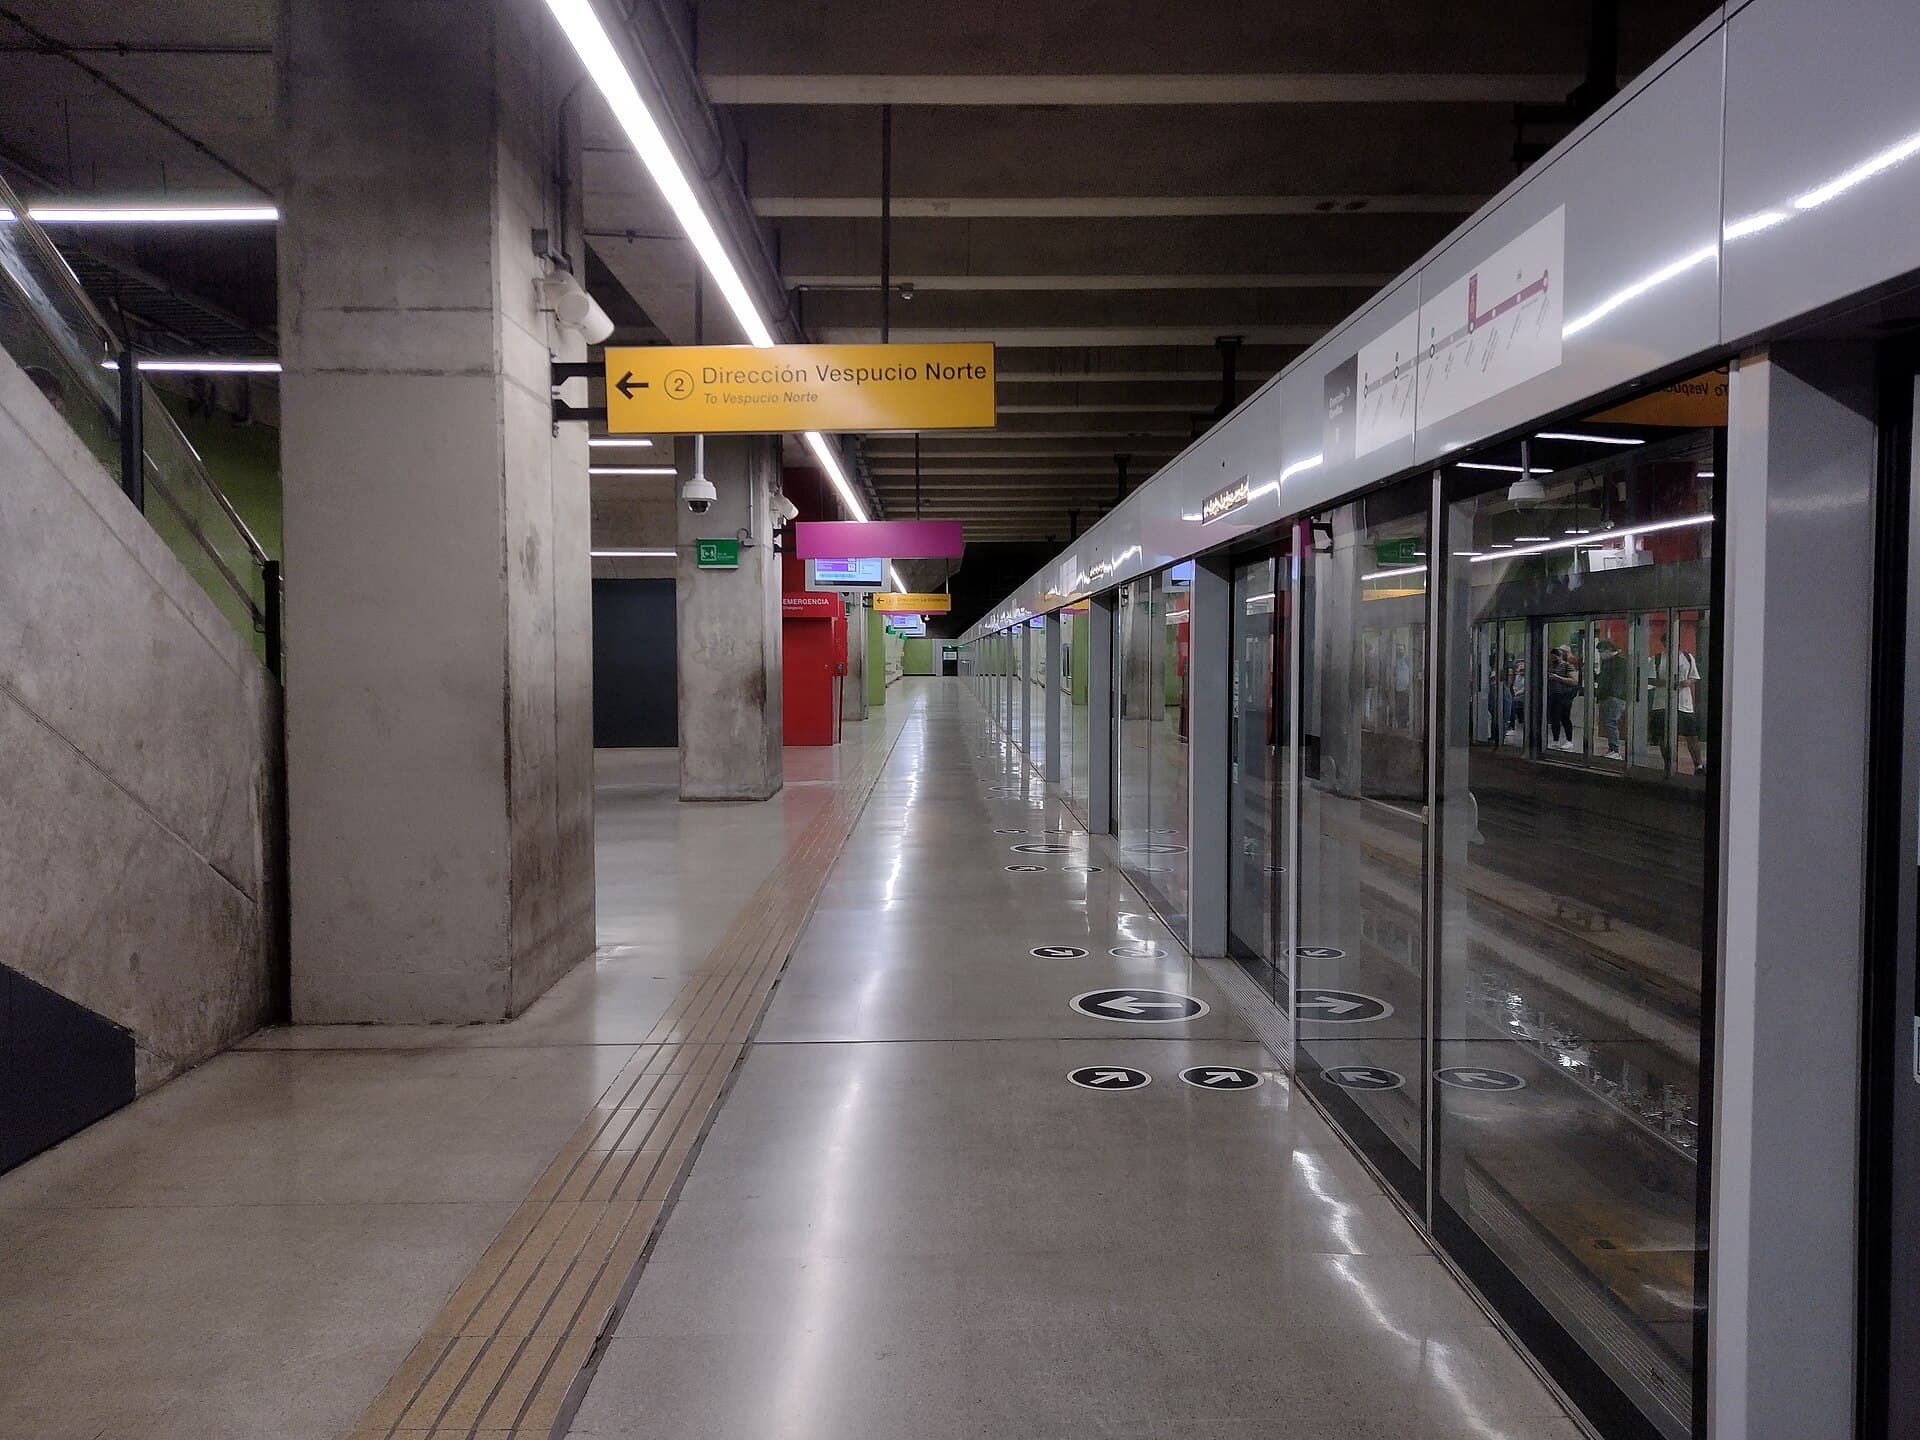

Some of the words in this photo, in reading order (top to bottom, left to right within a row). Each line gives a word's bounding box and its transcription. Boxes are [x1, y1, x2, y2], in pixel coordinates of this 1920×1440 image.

[674, 378, 684, 392] 2
[703, 365, 807, 384] Dirección
[815, 364, 917, 386] Vespucio
[925, 361, 987, 381] Norte
[704, 393, 718, 404] To
[722, 392, 779, 405] Vespucio
[783, 391, 818, 403] Norte
